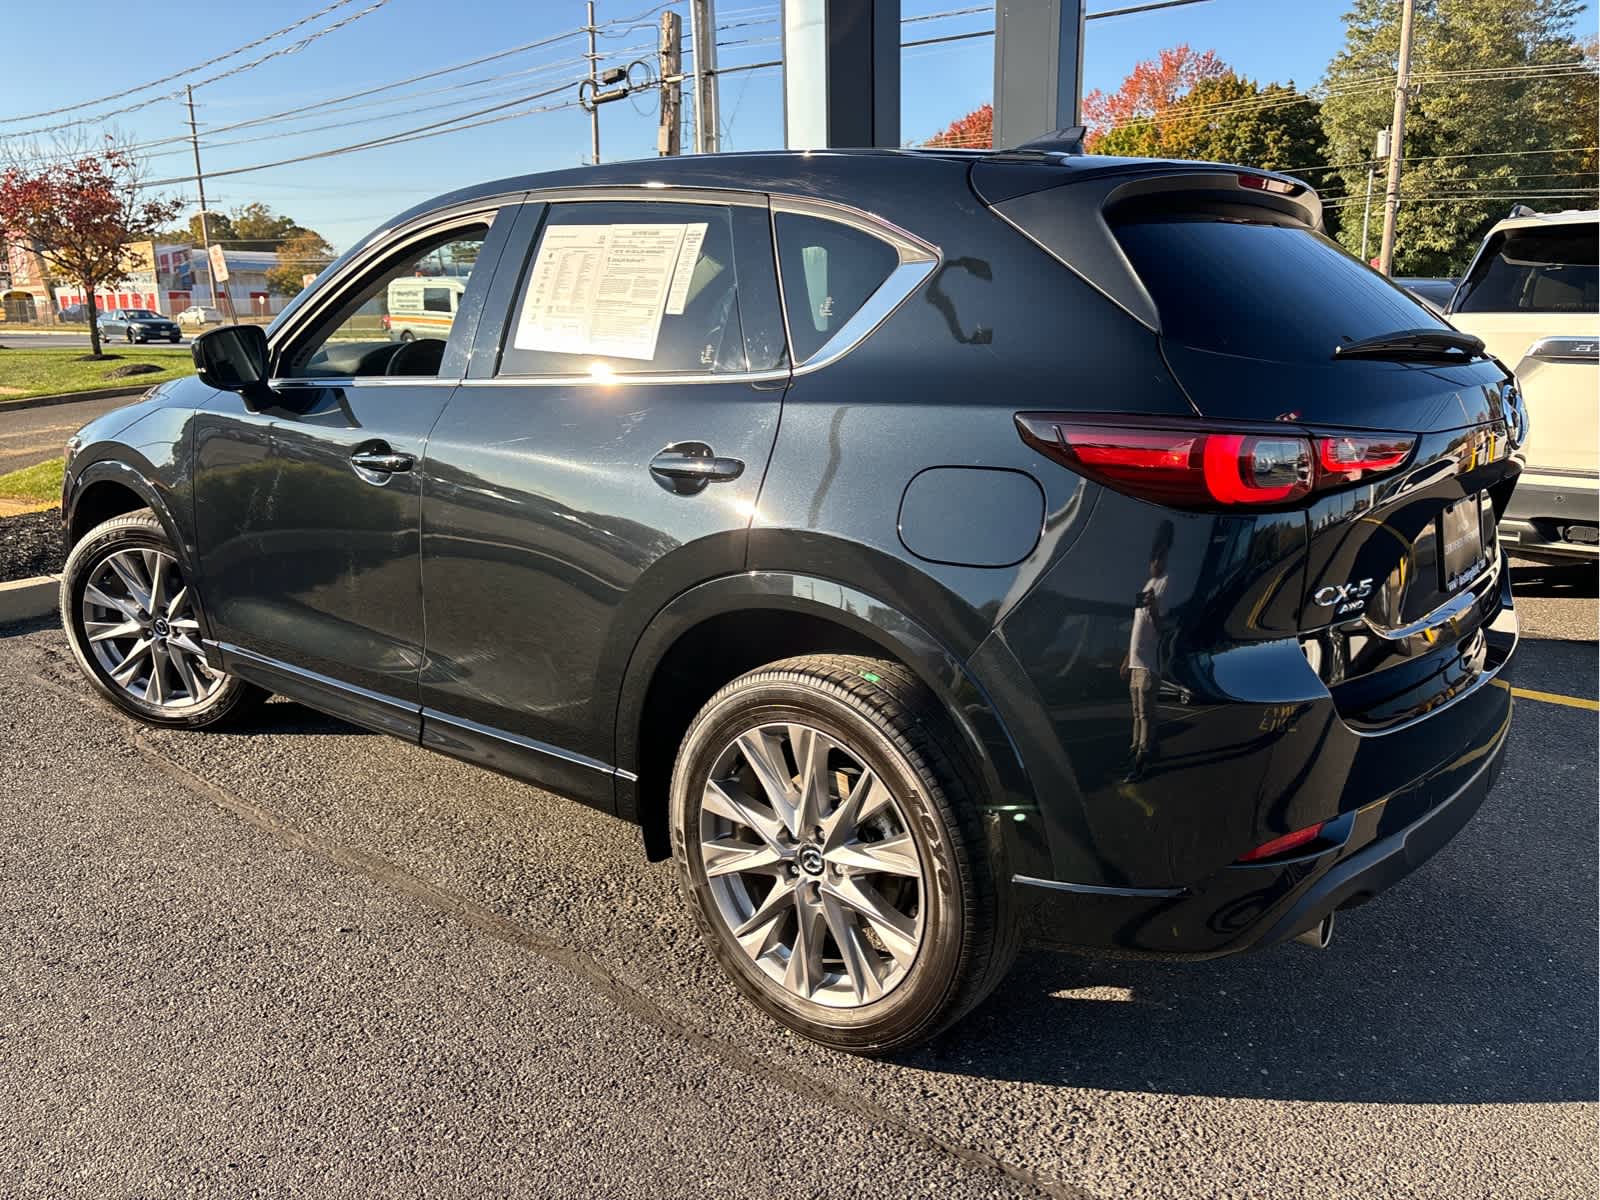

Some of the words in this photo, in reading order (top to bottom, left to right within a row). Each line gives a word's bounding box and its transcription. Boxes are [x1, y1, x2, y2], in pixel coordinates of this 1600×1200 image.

[1314, 577, 1374, 607] CX-5
[1338, 599, 1365, 614] AWD
[911, 788, 953, 898] TOYO
